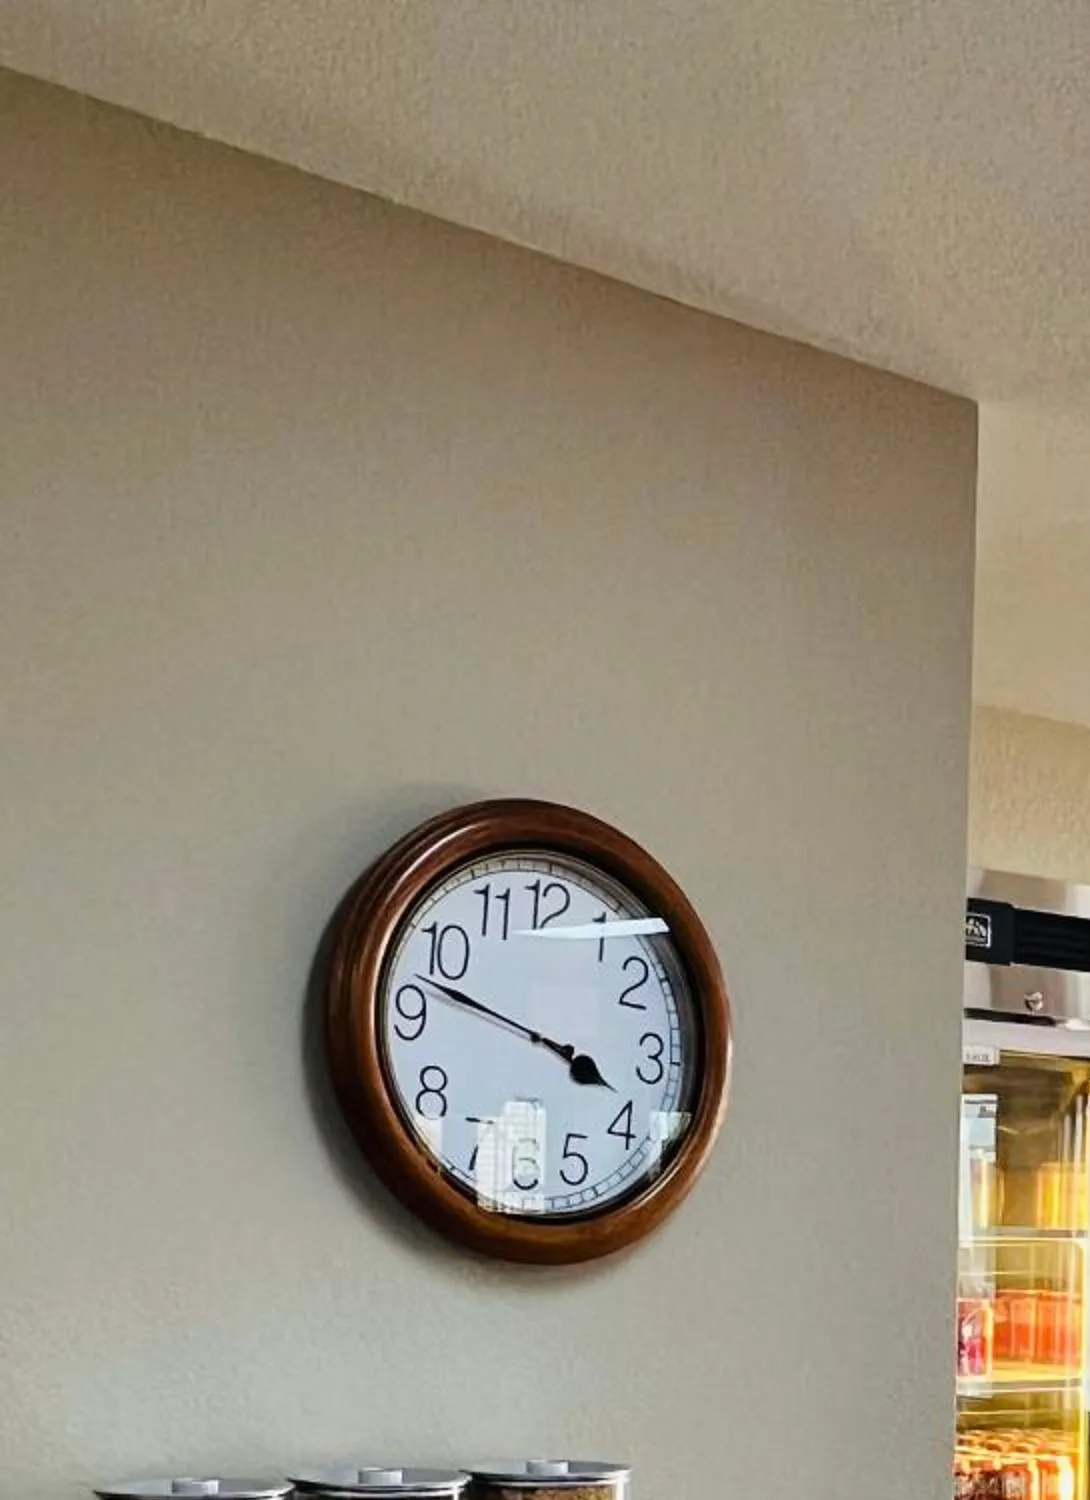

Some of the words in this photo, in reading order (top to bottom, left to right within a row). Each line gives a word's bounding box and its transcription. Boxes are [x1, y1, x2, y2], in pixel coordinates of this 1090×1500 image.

[474, 883, 512, 941] 11
[524, 879, 571, 932] 12
[421, 921, 470, 981] 10
[592, 911, 607, 963] 1
[618, 956, 650, 1010] 2
[393, 984, 428, 1041] 9
[635, 1032, 665, 1085] 3
[415, 1064, 449, 1118] 8
[606, 1099, 637, 1151] 4
[559, 1133, 589, 1186] 5
